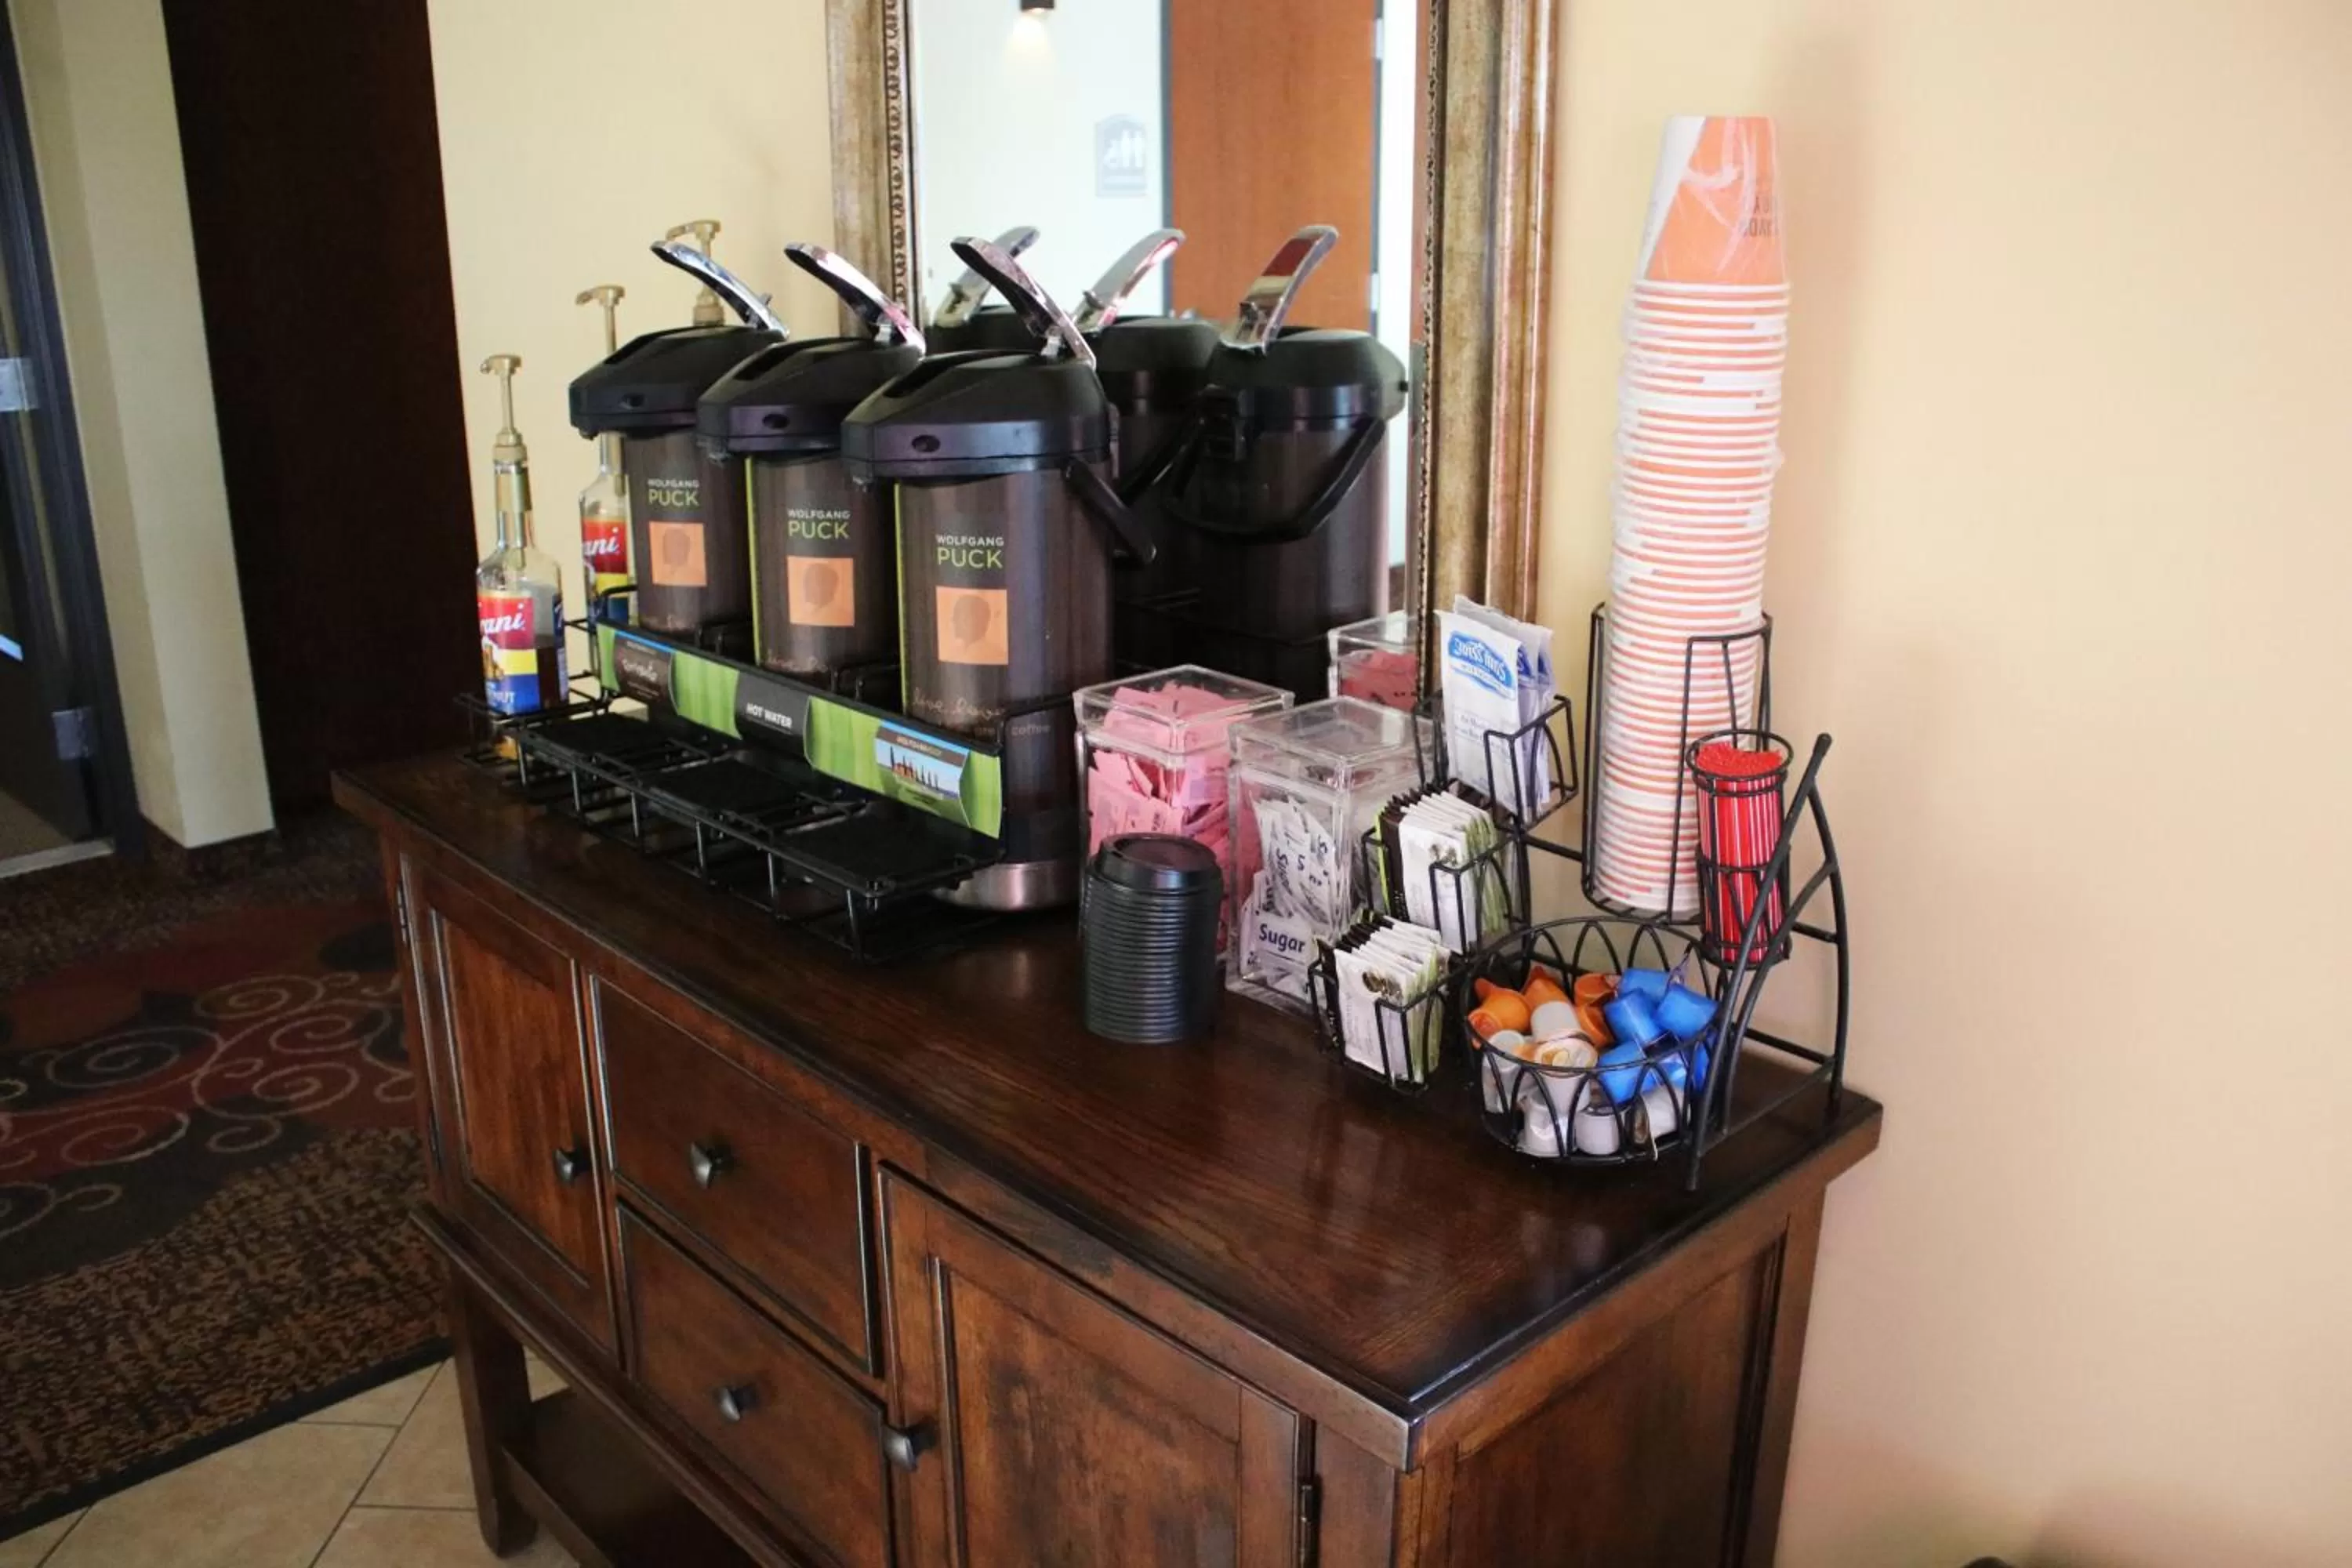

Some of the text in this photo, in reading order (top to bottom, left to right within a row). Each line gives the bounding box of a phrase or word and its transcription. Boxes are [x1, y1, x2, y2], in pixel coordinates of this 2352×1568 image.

[648, 478, 699, 488] WOLFGANG
[648, 489, 699, 506] PUCK
[787, 509, 851, 519] WOLFGANG
[788, 521, 849, 539] PUCK
[935, 535, 1004, 546] WOLFGANG
[937, 547, 1003, 568] PUCK
[746, 702, 793, 728] HOT WATER
[1259, 924, 1305, 953] Sugar
